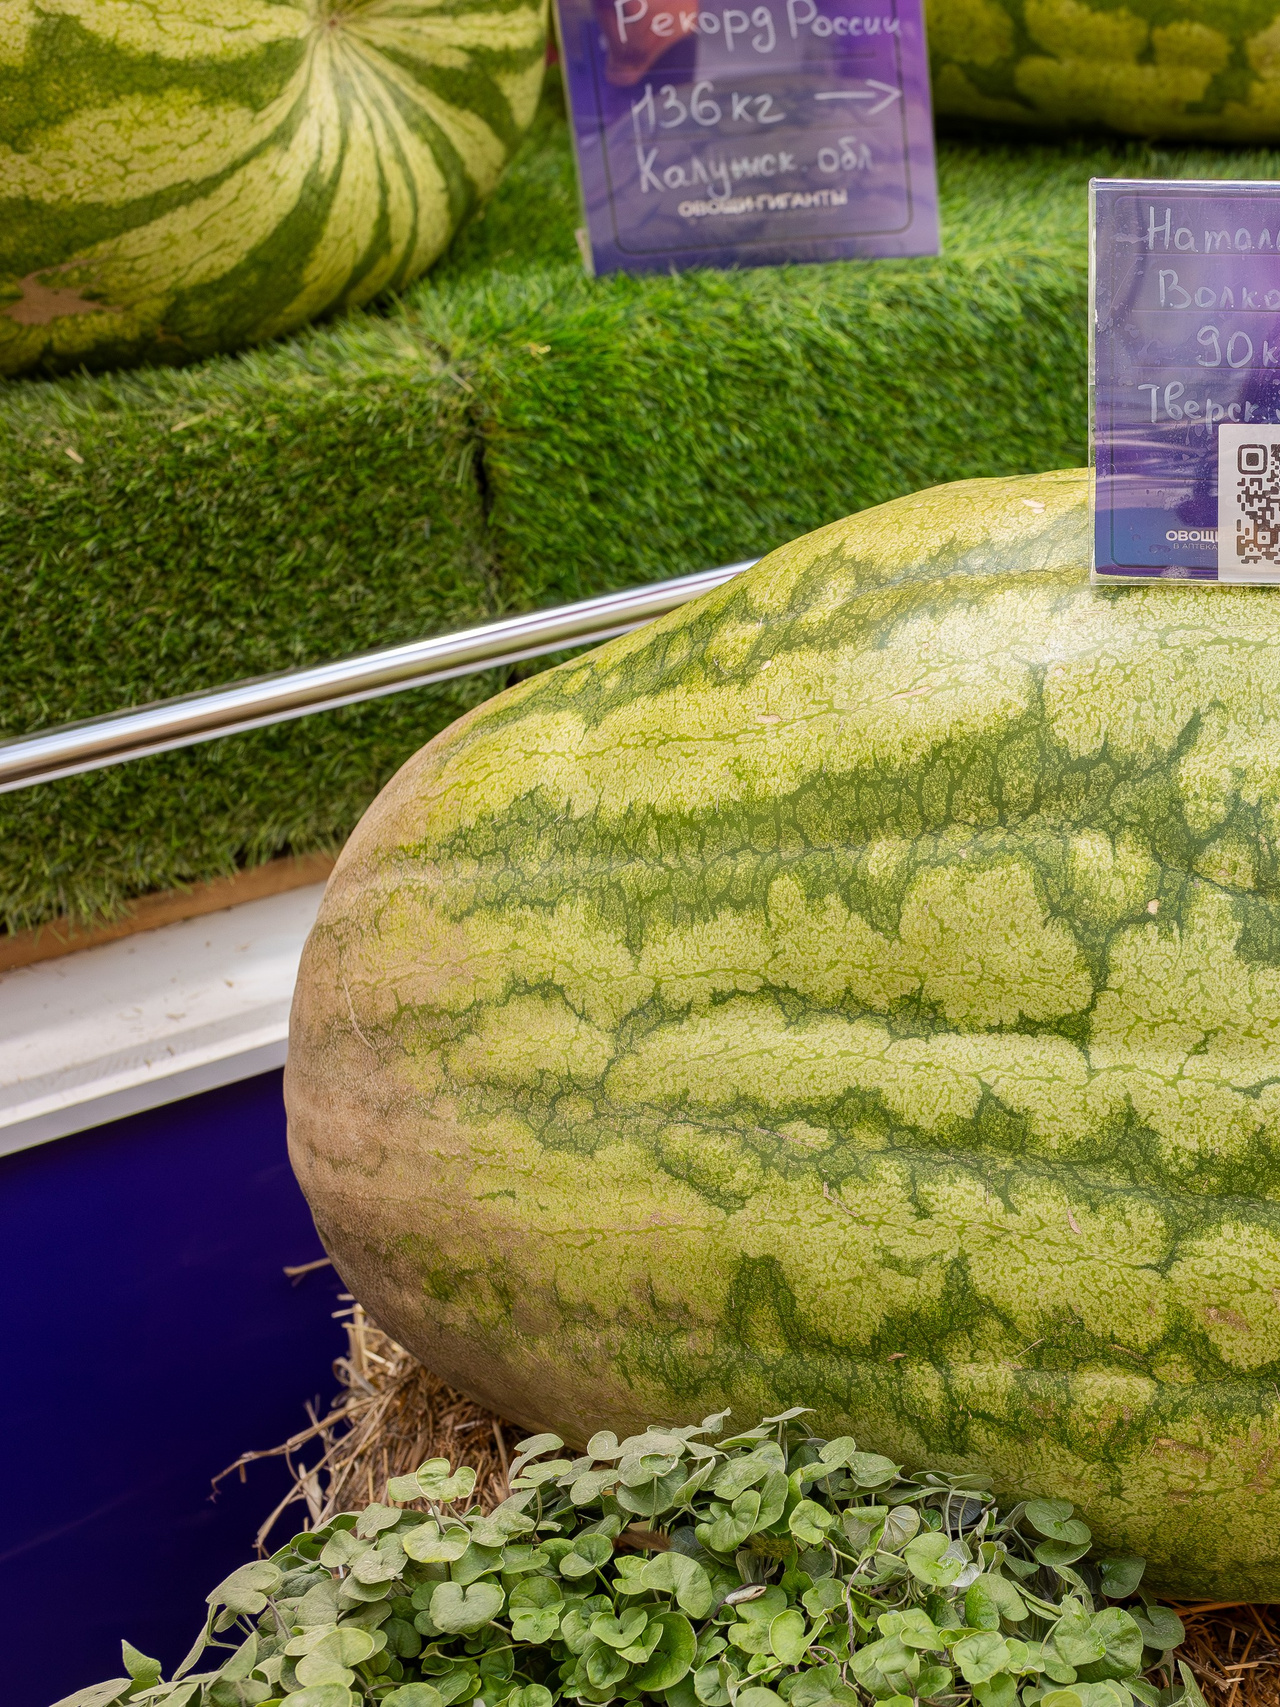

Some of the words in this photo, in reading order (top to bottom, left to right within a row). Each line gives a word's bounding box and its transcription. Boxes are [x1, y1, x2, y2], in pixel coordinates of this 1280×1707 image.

[614, 0, 776, 53] Рекорд
[786, 0, 901, 39] России
[632, 80, 722, 135] 136
